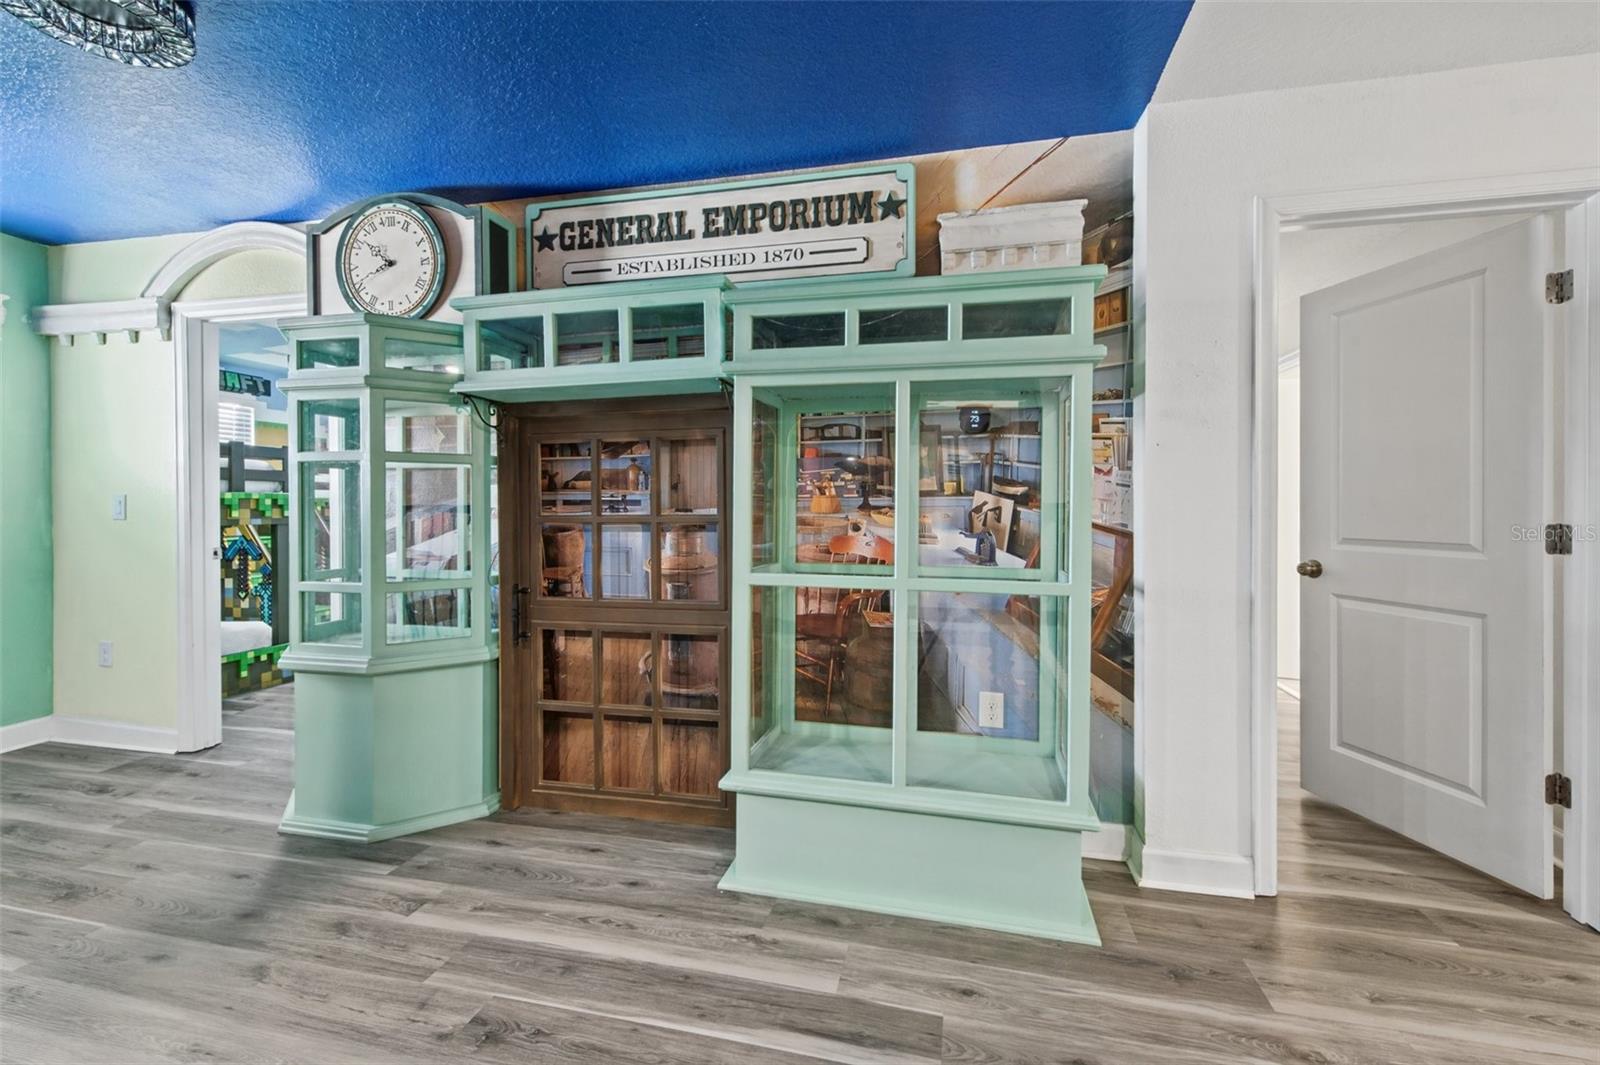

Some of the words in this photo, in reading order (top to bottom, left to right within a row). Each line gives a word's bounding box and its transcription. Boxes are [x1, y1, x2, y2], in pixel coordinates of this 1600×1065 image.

[379, 216, 396, 227] VIII
[401, 220, 411, 232] IX
[559, 209, 694, 252] GENERAL
[702, 190, 875, 238] EMPORIUM
[363, 222, 378, 235] VII
[416, 237, 425, 247] X
[617, 251, 756, 276] ESTABLISHED
[763, 247, 804, 264] 1870
[369, 295, 379, 307] III
[388, 300, 394, 311] II
